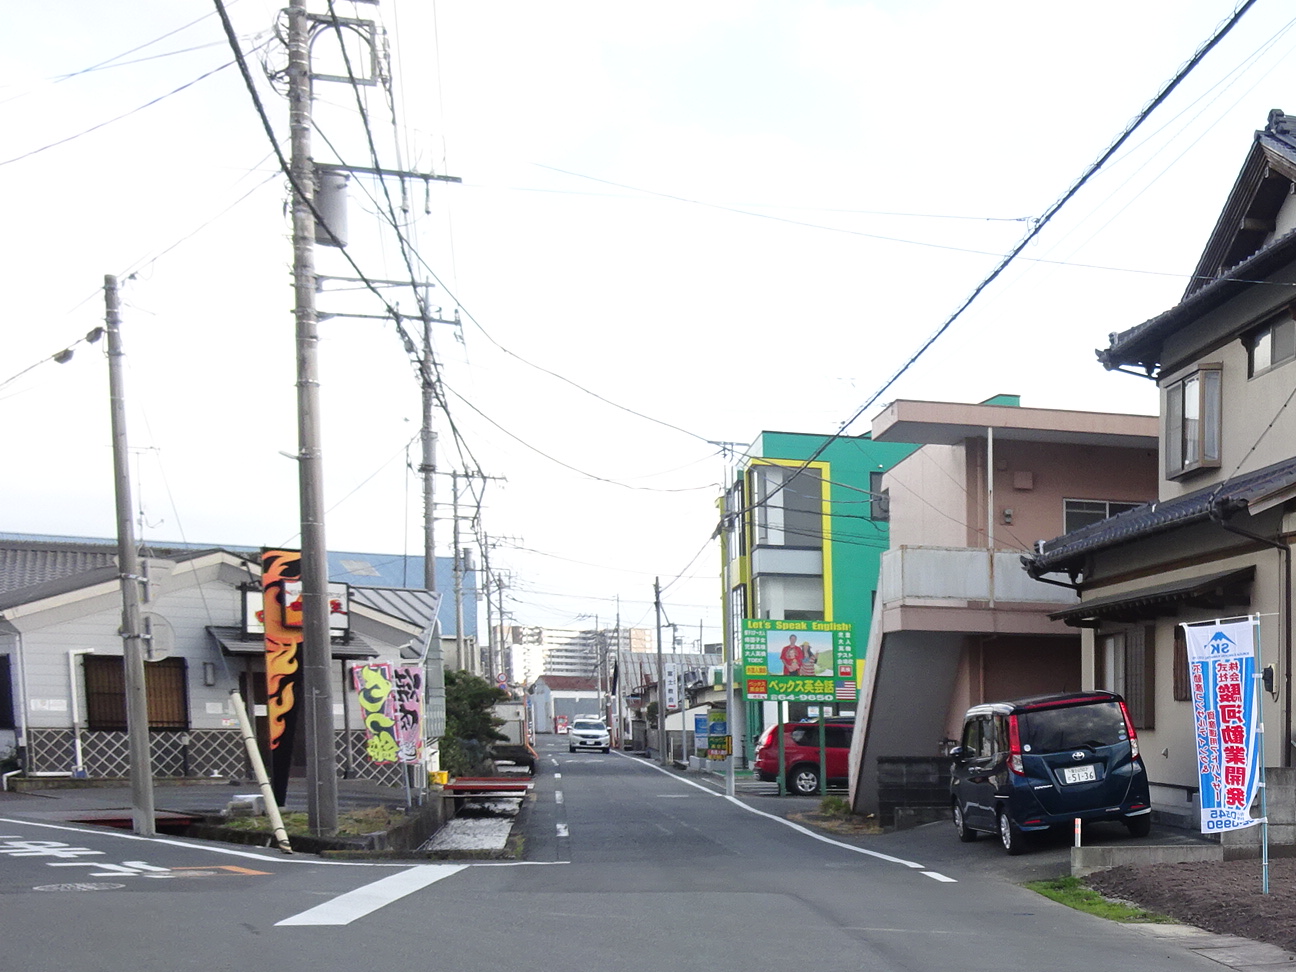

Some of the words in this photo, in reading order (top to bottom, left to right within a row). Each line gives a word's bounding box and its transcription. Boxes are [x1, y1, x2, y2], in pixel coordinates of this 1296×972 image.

[747, 620, 771, 630] Let's
[776, 621, 807, 631] Speak
[812, 622, 852, 631] English!
[769, 680, 835, 693] ベックス英会話
[1071, 771, 1094, 782] 51-36
